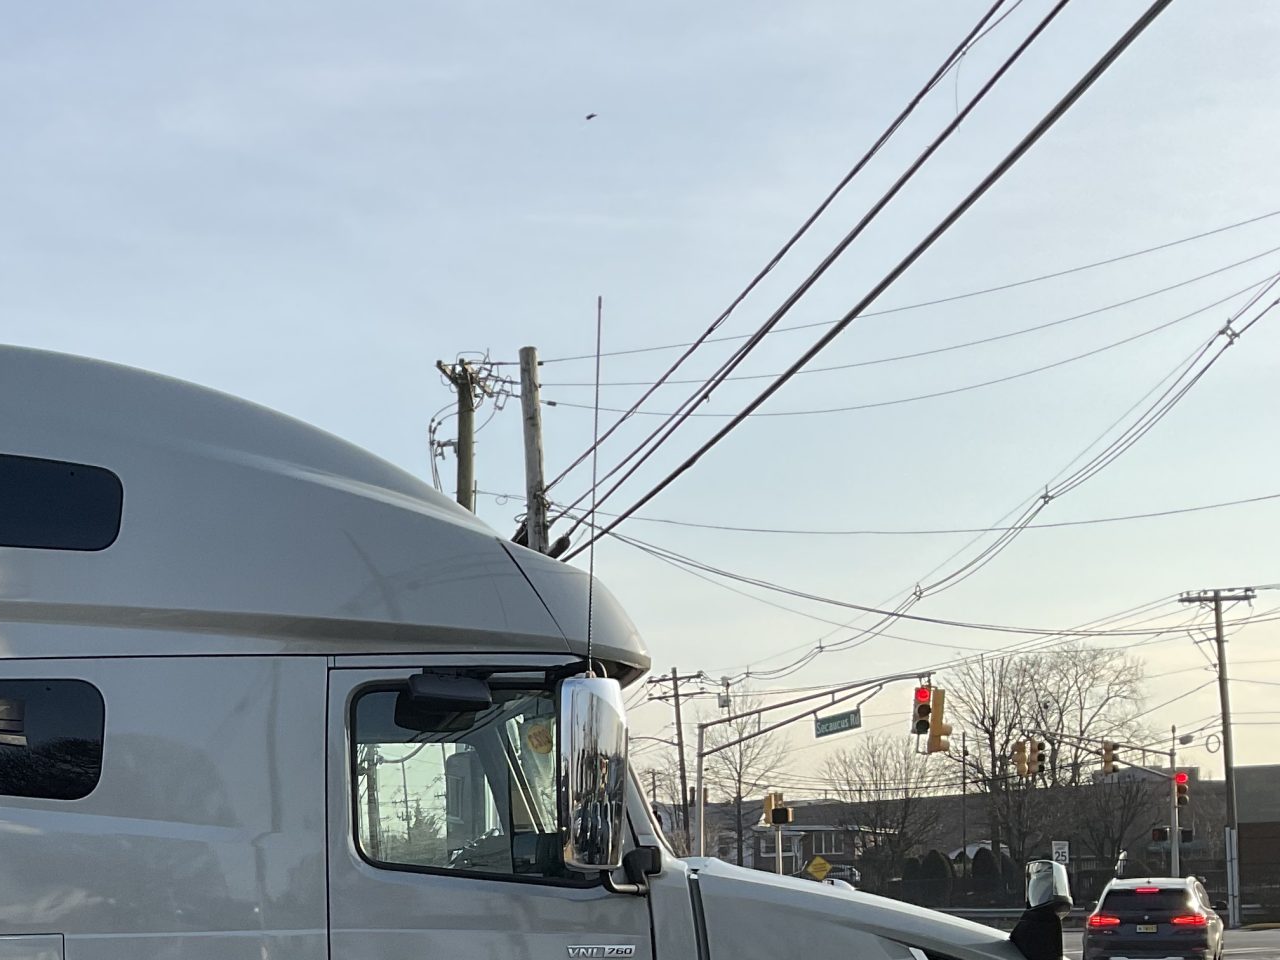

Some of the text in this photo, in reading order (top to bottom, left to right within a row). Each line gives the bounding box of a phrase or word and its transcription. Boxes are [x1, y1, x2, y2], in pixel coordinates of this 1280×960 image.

[816, 712, 860, 734] Secaucus Rd
[1055, 850, 1067, 861] 25
[566, 947, 633, 958] VNL 760
